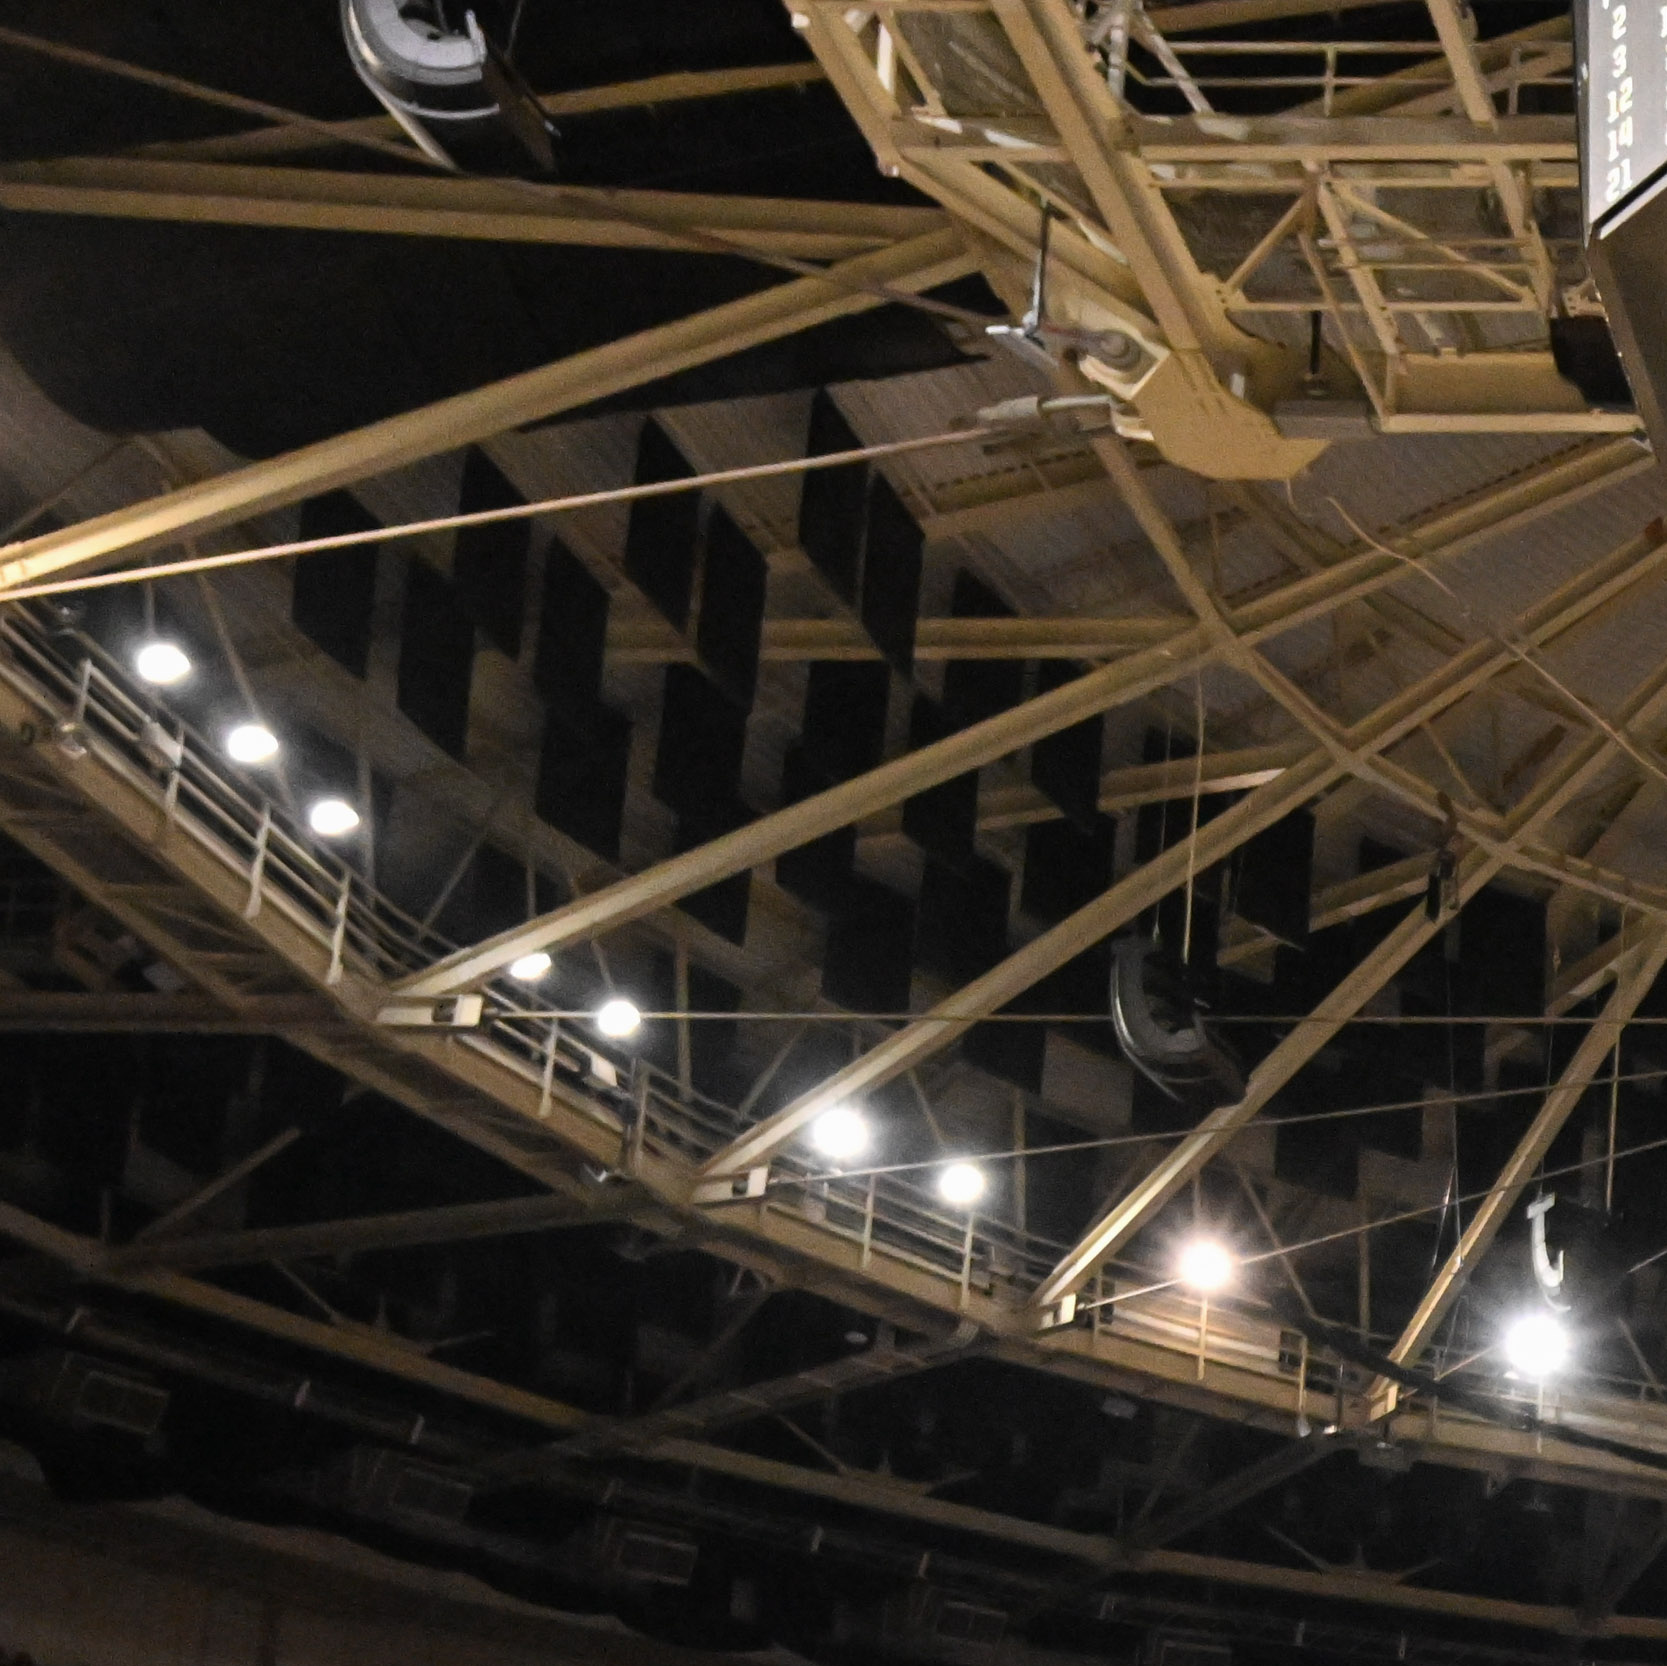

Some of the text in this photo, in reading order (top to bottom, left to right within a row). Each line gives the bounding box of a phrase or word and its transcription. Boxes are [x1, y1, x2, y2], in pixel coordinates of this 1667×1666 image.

[1612, 5, 1627, 40] 2
[1613, 45, 1627, 78] 3
[1608, 77, 1633, 123] 12
[1605, 159, 1632, 203] 21
